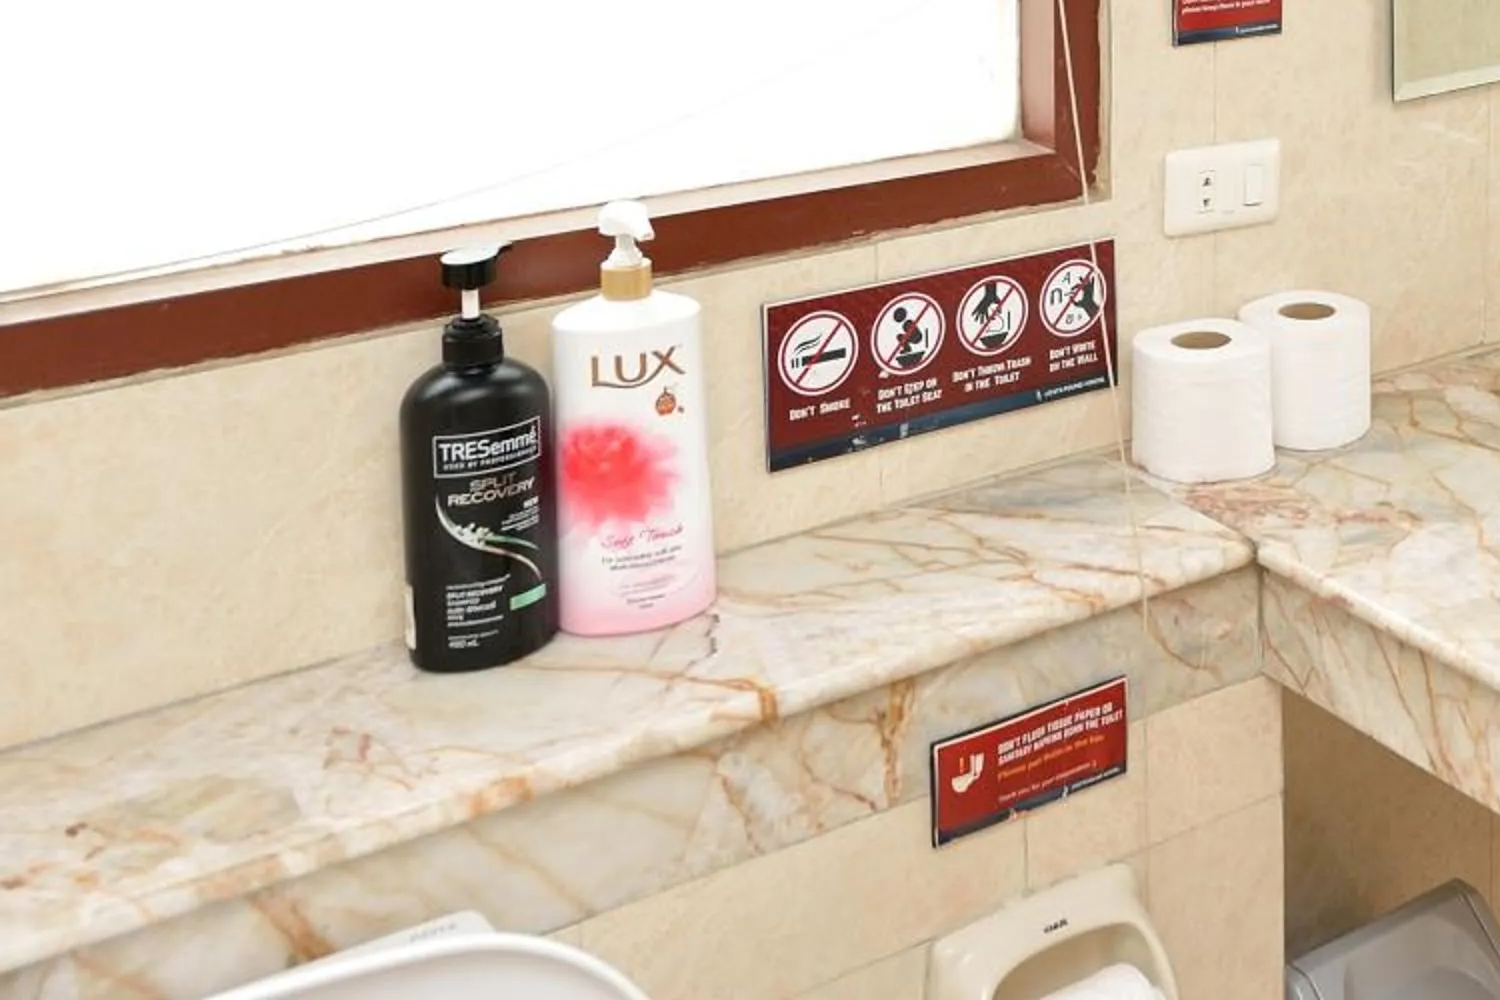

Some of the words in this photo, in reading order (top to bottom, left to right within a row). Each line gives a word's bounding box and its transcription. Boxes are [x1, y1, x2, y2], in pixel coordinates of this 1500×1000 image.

[1050, 345, 1071, 360] DON'T
[1071, 339, 1097, 353] WRITE
[591, 346, 686, 388] LUX
[952, 367, 976, 383] DON'T
[977, 362, 1005, 377] THROW
[1006, 356, 1032, 370] TRASH
[1049, 361, 1060, 373] ON
[1061, 356, 1075, 369] THE
[1076, 351, 1098, 365] WALL
[877, 385, 903, 400] DON'T
[904, 380, 924, 395] STEP
[925, 378, 937, 390] ON
[964, 381, 973, 392] IN
[975, 378, 991, 390] THE
[994, 371, 1021, 385] TOILET
[789, 405, 815, 421] DON'T
[819, 399, 850, 414] SMOKE
[876, 401, 893, 414] THE
[894, 396, 921, 410] TOILET
[922, 389, 943, 403] SEAT
[438, 425, 538, 463] TRESemmé
[447, 476, 535, 507] RECOVERY
[469, 471, 517, 493] SPLIT
[998, 737, 1020, 754] DON'T
[1022, 725, 1045, 746] FLUSH
[1047, 714, 1073, 733] TISSUE
[1074, 706, 1101, 723] PAPER
[1102, 701, 1113, 714] OR
[1063, 722, 1085, 740] DOWN
[1085, 718, 1099, 731] THE
[1101, 709, 1123, 726] TOILET
[997, 763, 1027, 782] Please
